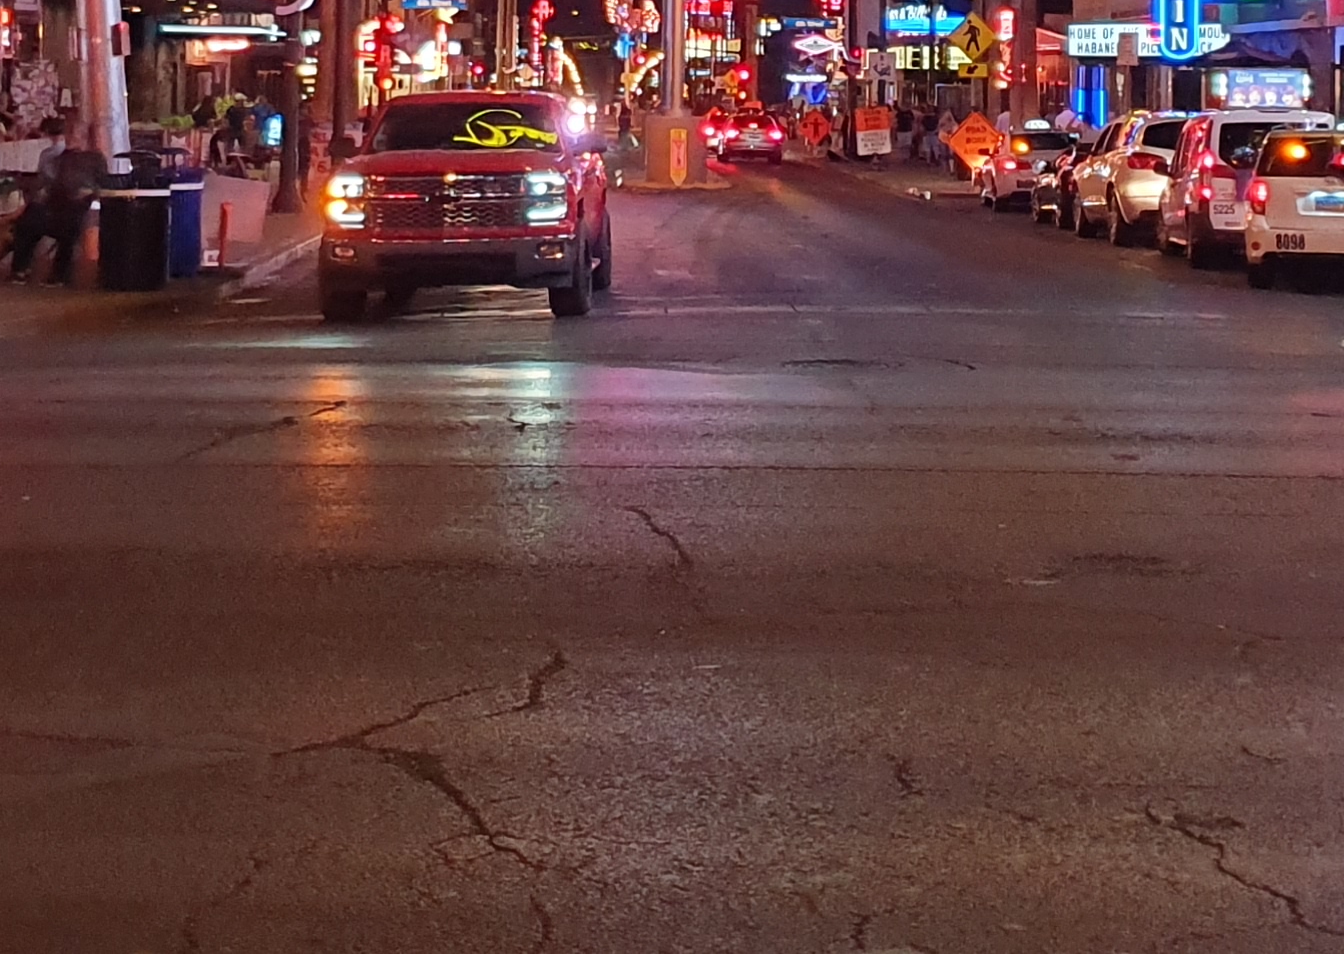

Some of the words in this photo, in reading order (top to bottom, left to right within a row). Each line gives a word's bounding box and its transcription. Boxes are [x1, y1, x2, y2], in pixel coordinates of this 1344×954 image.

[1069, 27, 1097, 40] HOME
[1102, 27, 1114, 40] OF
[1077, 42, 1115, 54] HABANE
[1212, 203, 1236, 215] 5225
[1275, 233, 1306, 250] 8098
